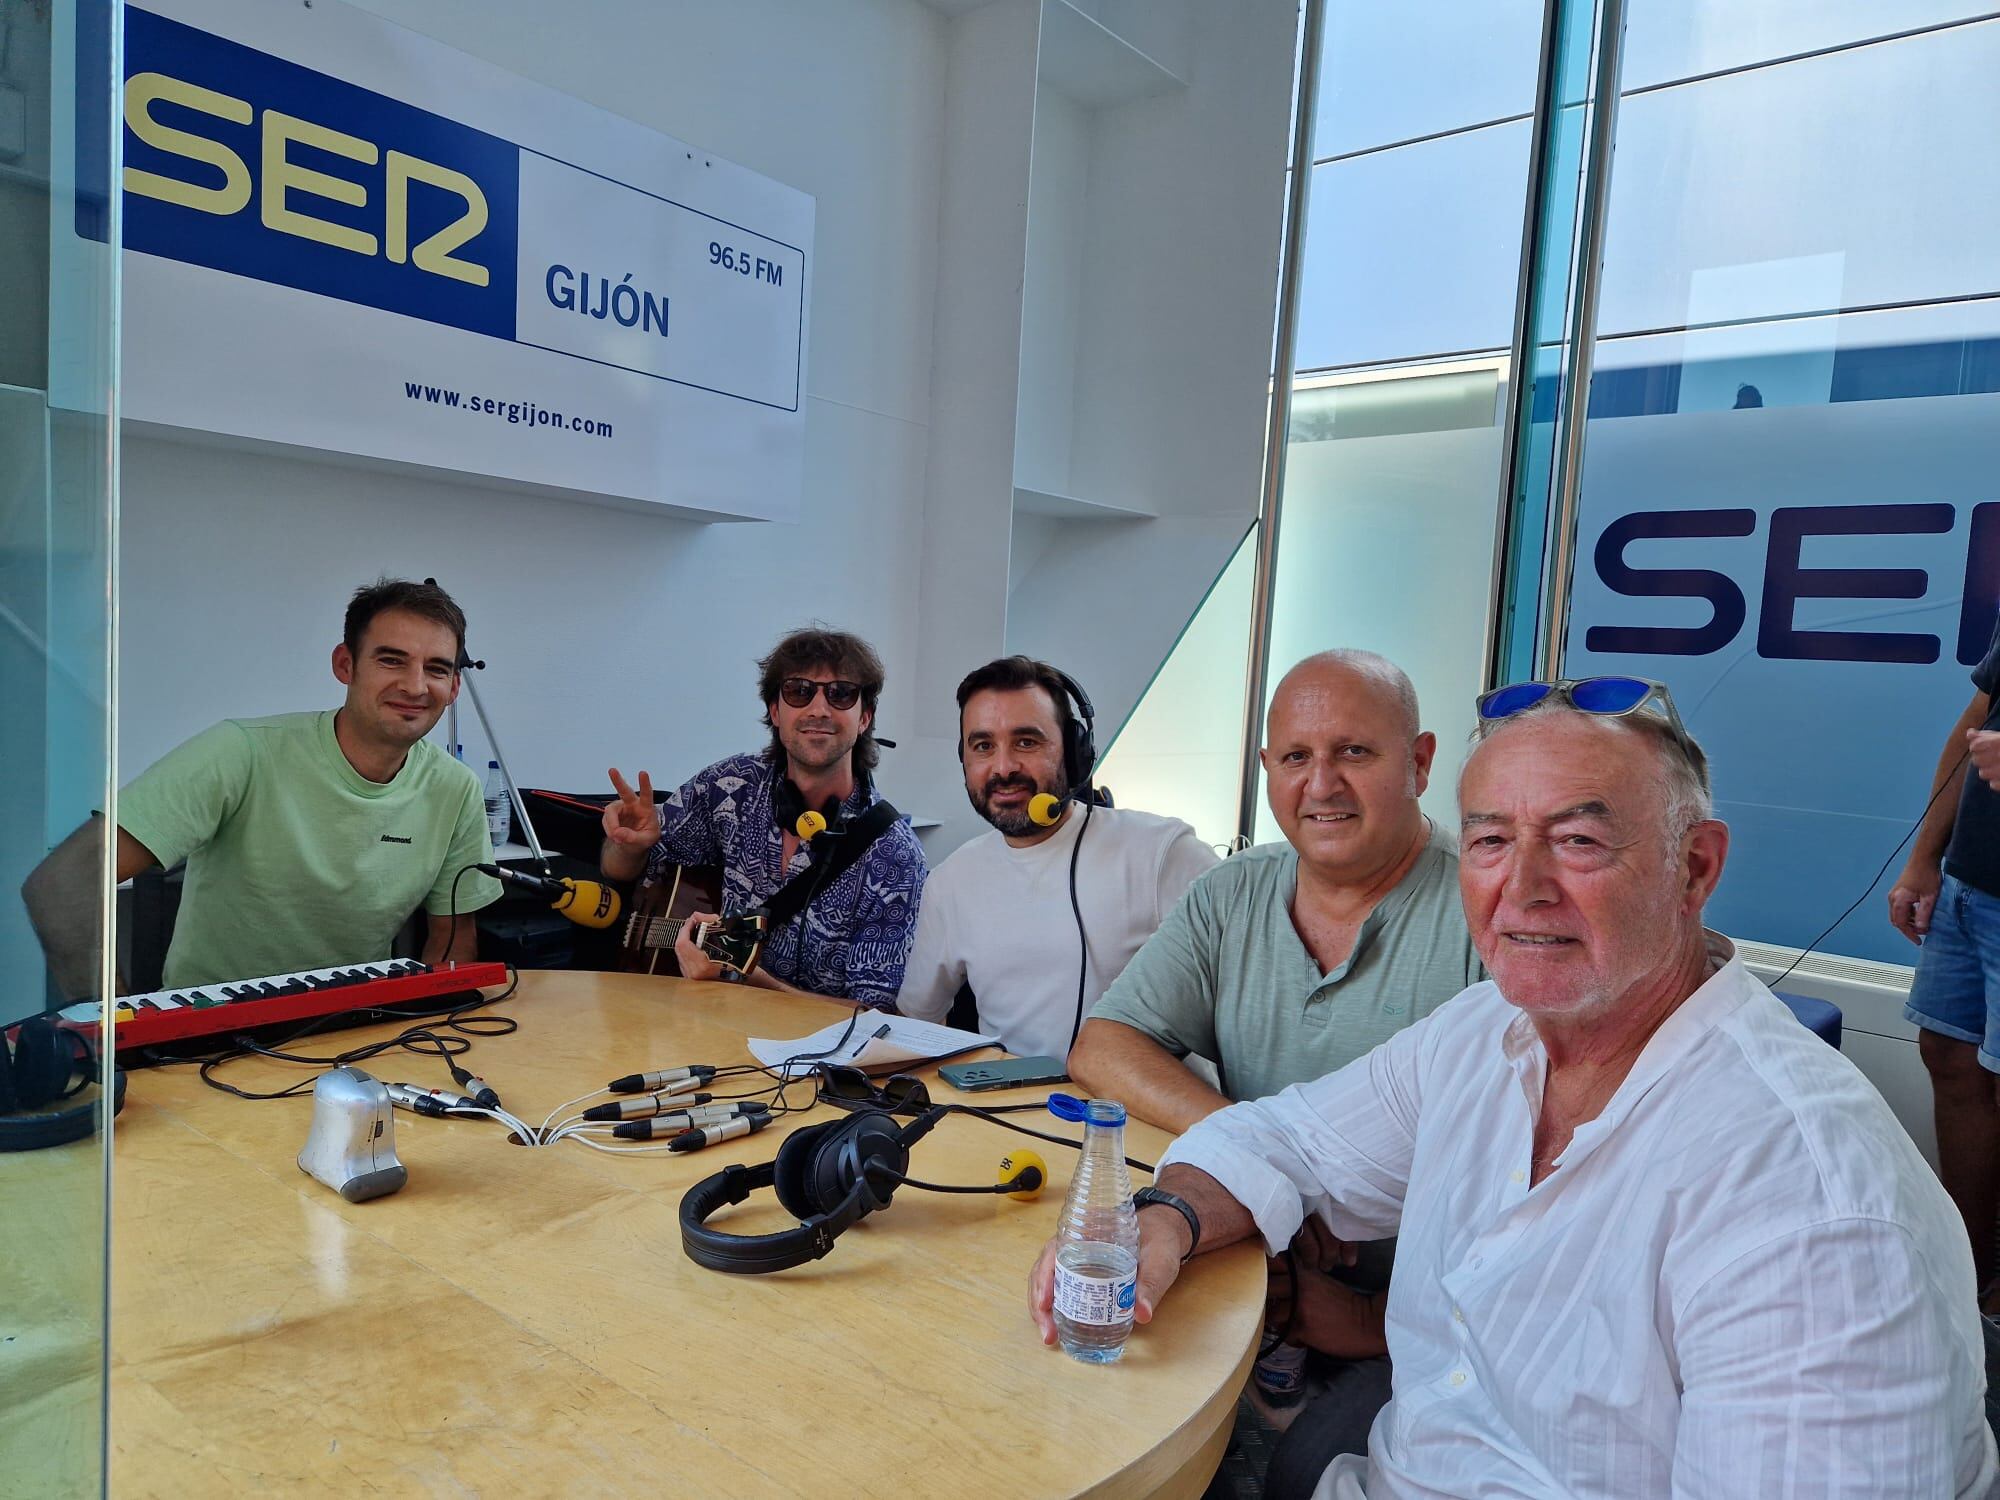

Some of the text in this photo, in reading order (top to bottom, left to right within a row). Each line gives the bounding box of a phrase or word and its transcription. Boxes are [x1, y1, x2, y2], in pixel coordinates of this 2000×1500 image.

[123, 72, 490, 287] SER
[709, 241, 783, 287] 96.5 FM
[545, 264, 670, 338] GIJÓN
[404, 381, 613, 439] www.sergijon.com
